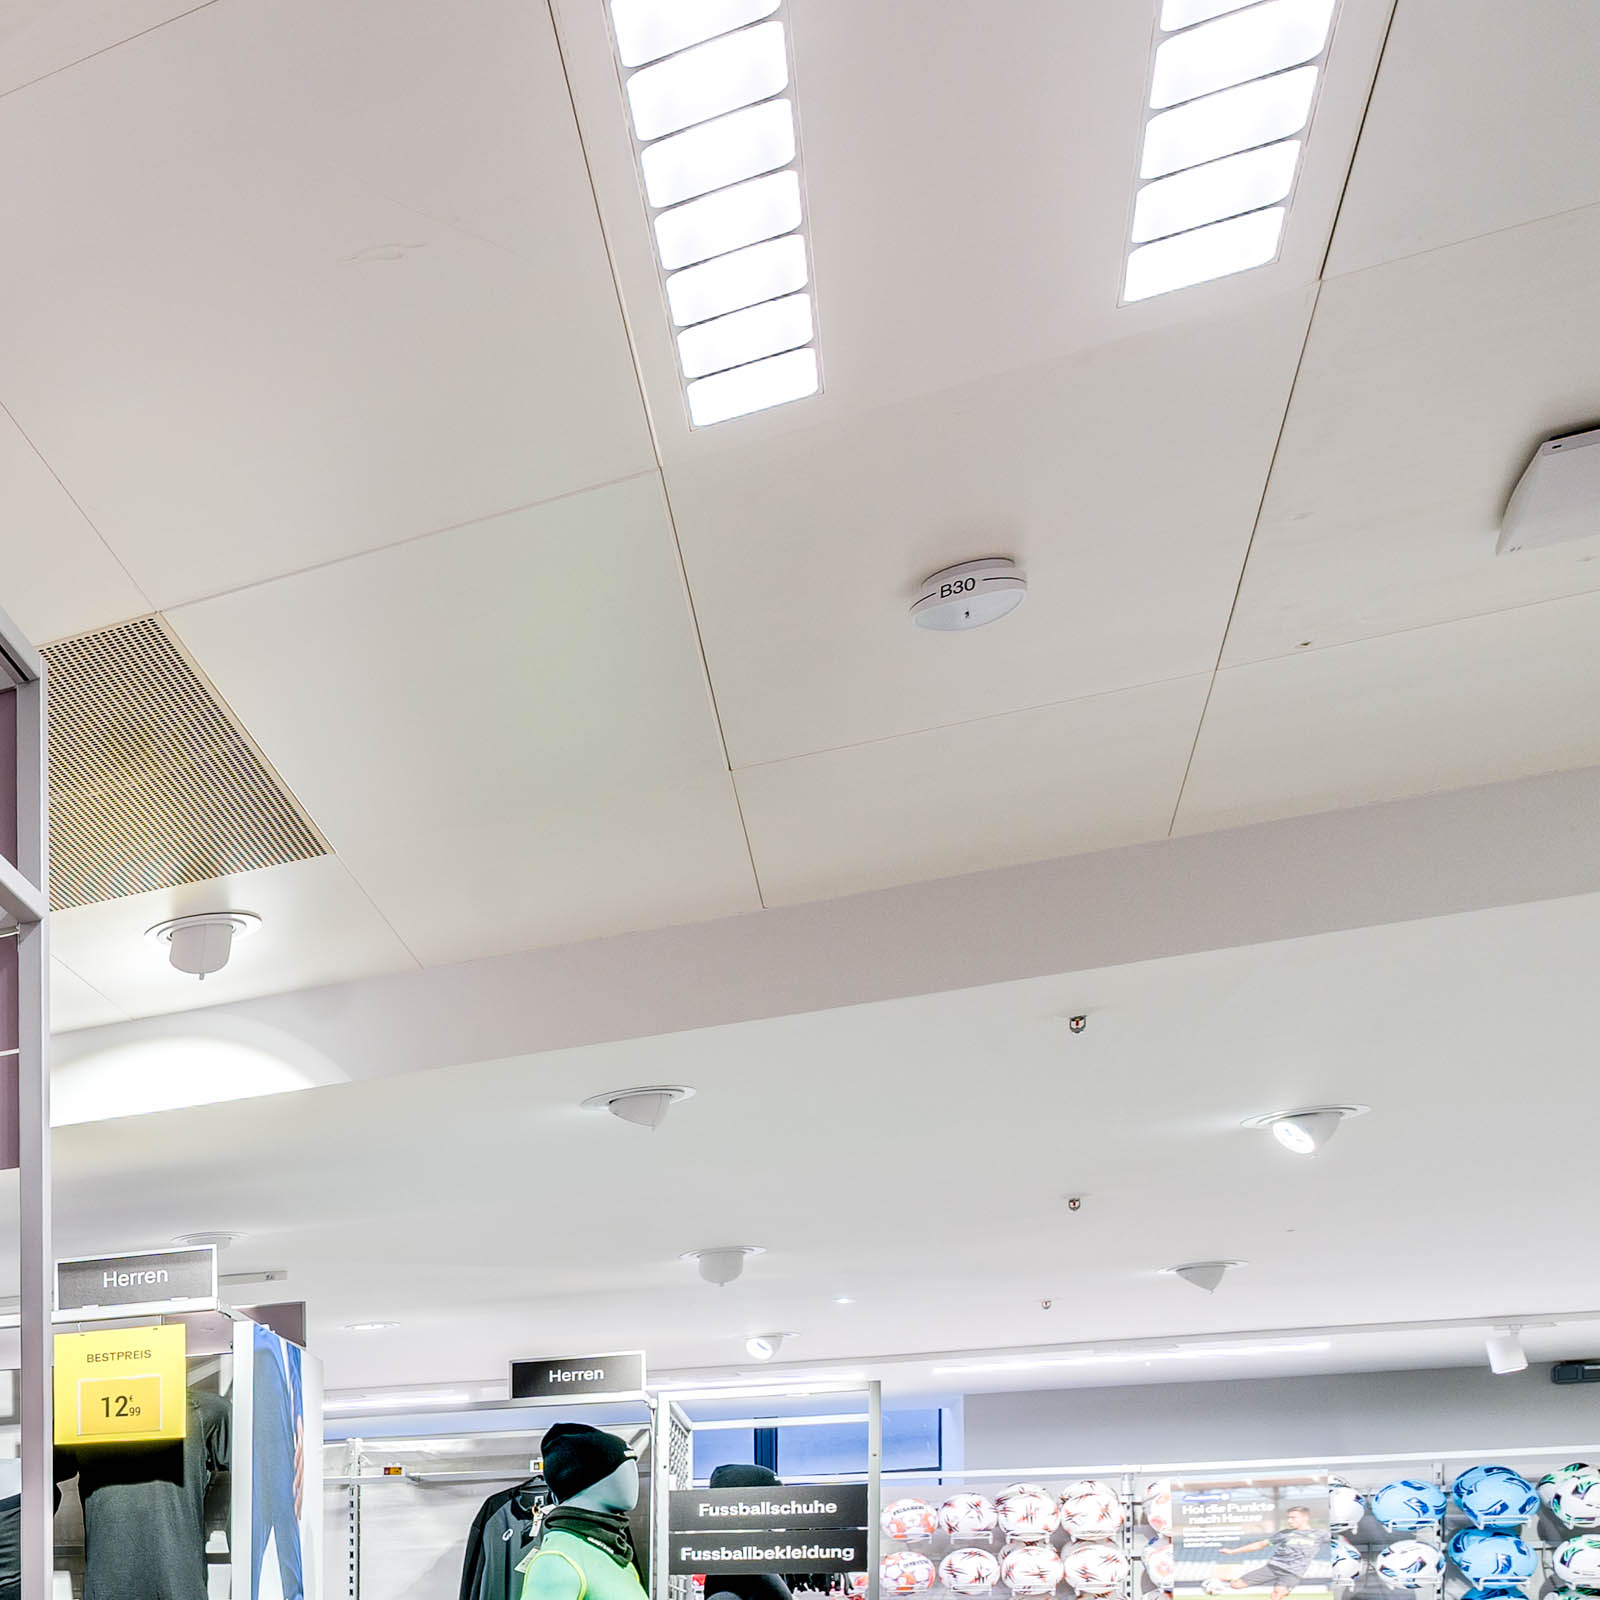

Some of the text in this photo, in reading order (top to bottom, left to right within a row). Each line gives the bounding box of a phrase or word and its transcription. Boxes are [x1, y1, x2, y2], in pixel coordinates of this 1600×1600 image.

[940, 577, 976, 599] B30
[103, 1269, 169, 1289] Herren
[86, 1349, 152, 1363] BESTPREIS
[548, 1367, 605, 1383] Herren
[698, 1500, 838, 1517] Fussballschuhe
[680, 1544, 855, 1562] Fussballbekleidung
